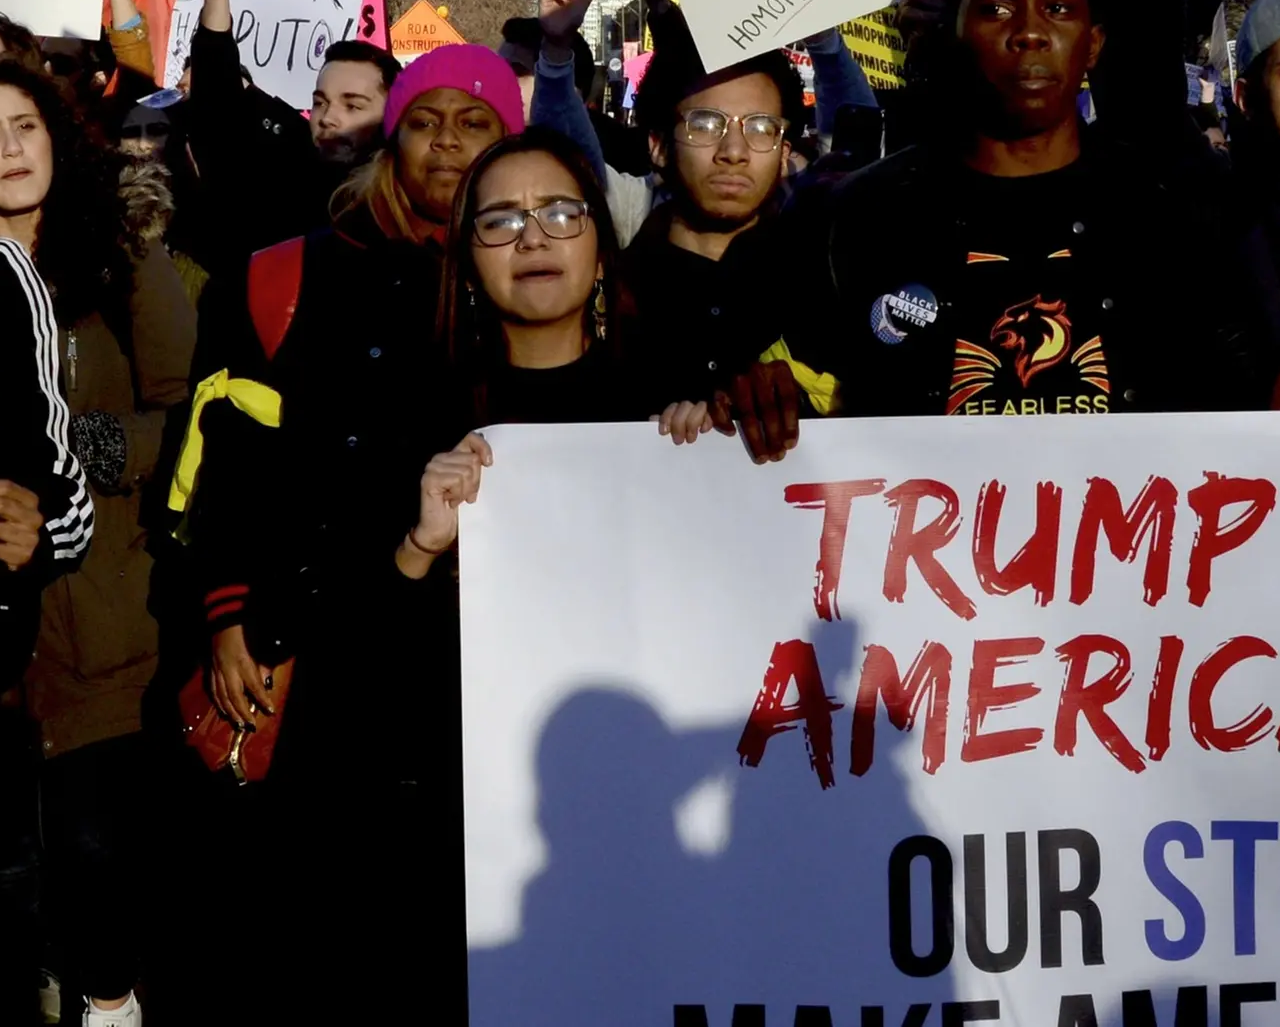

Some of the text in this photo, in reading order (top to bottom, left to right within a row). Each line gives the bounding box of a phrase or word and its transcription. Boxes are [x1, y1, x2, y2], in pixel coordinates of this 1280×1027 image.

[408, 23, 437, 35] ROAD
[895, 299, 929, 319] LIVES
[899, 290, 933, 310] BLACK
[891, 308, 927, 328] MATTER
[783, 470, 1277, 621] TRUMP
[886, 828, 1106, 978] OUR
